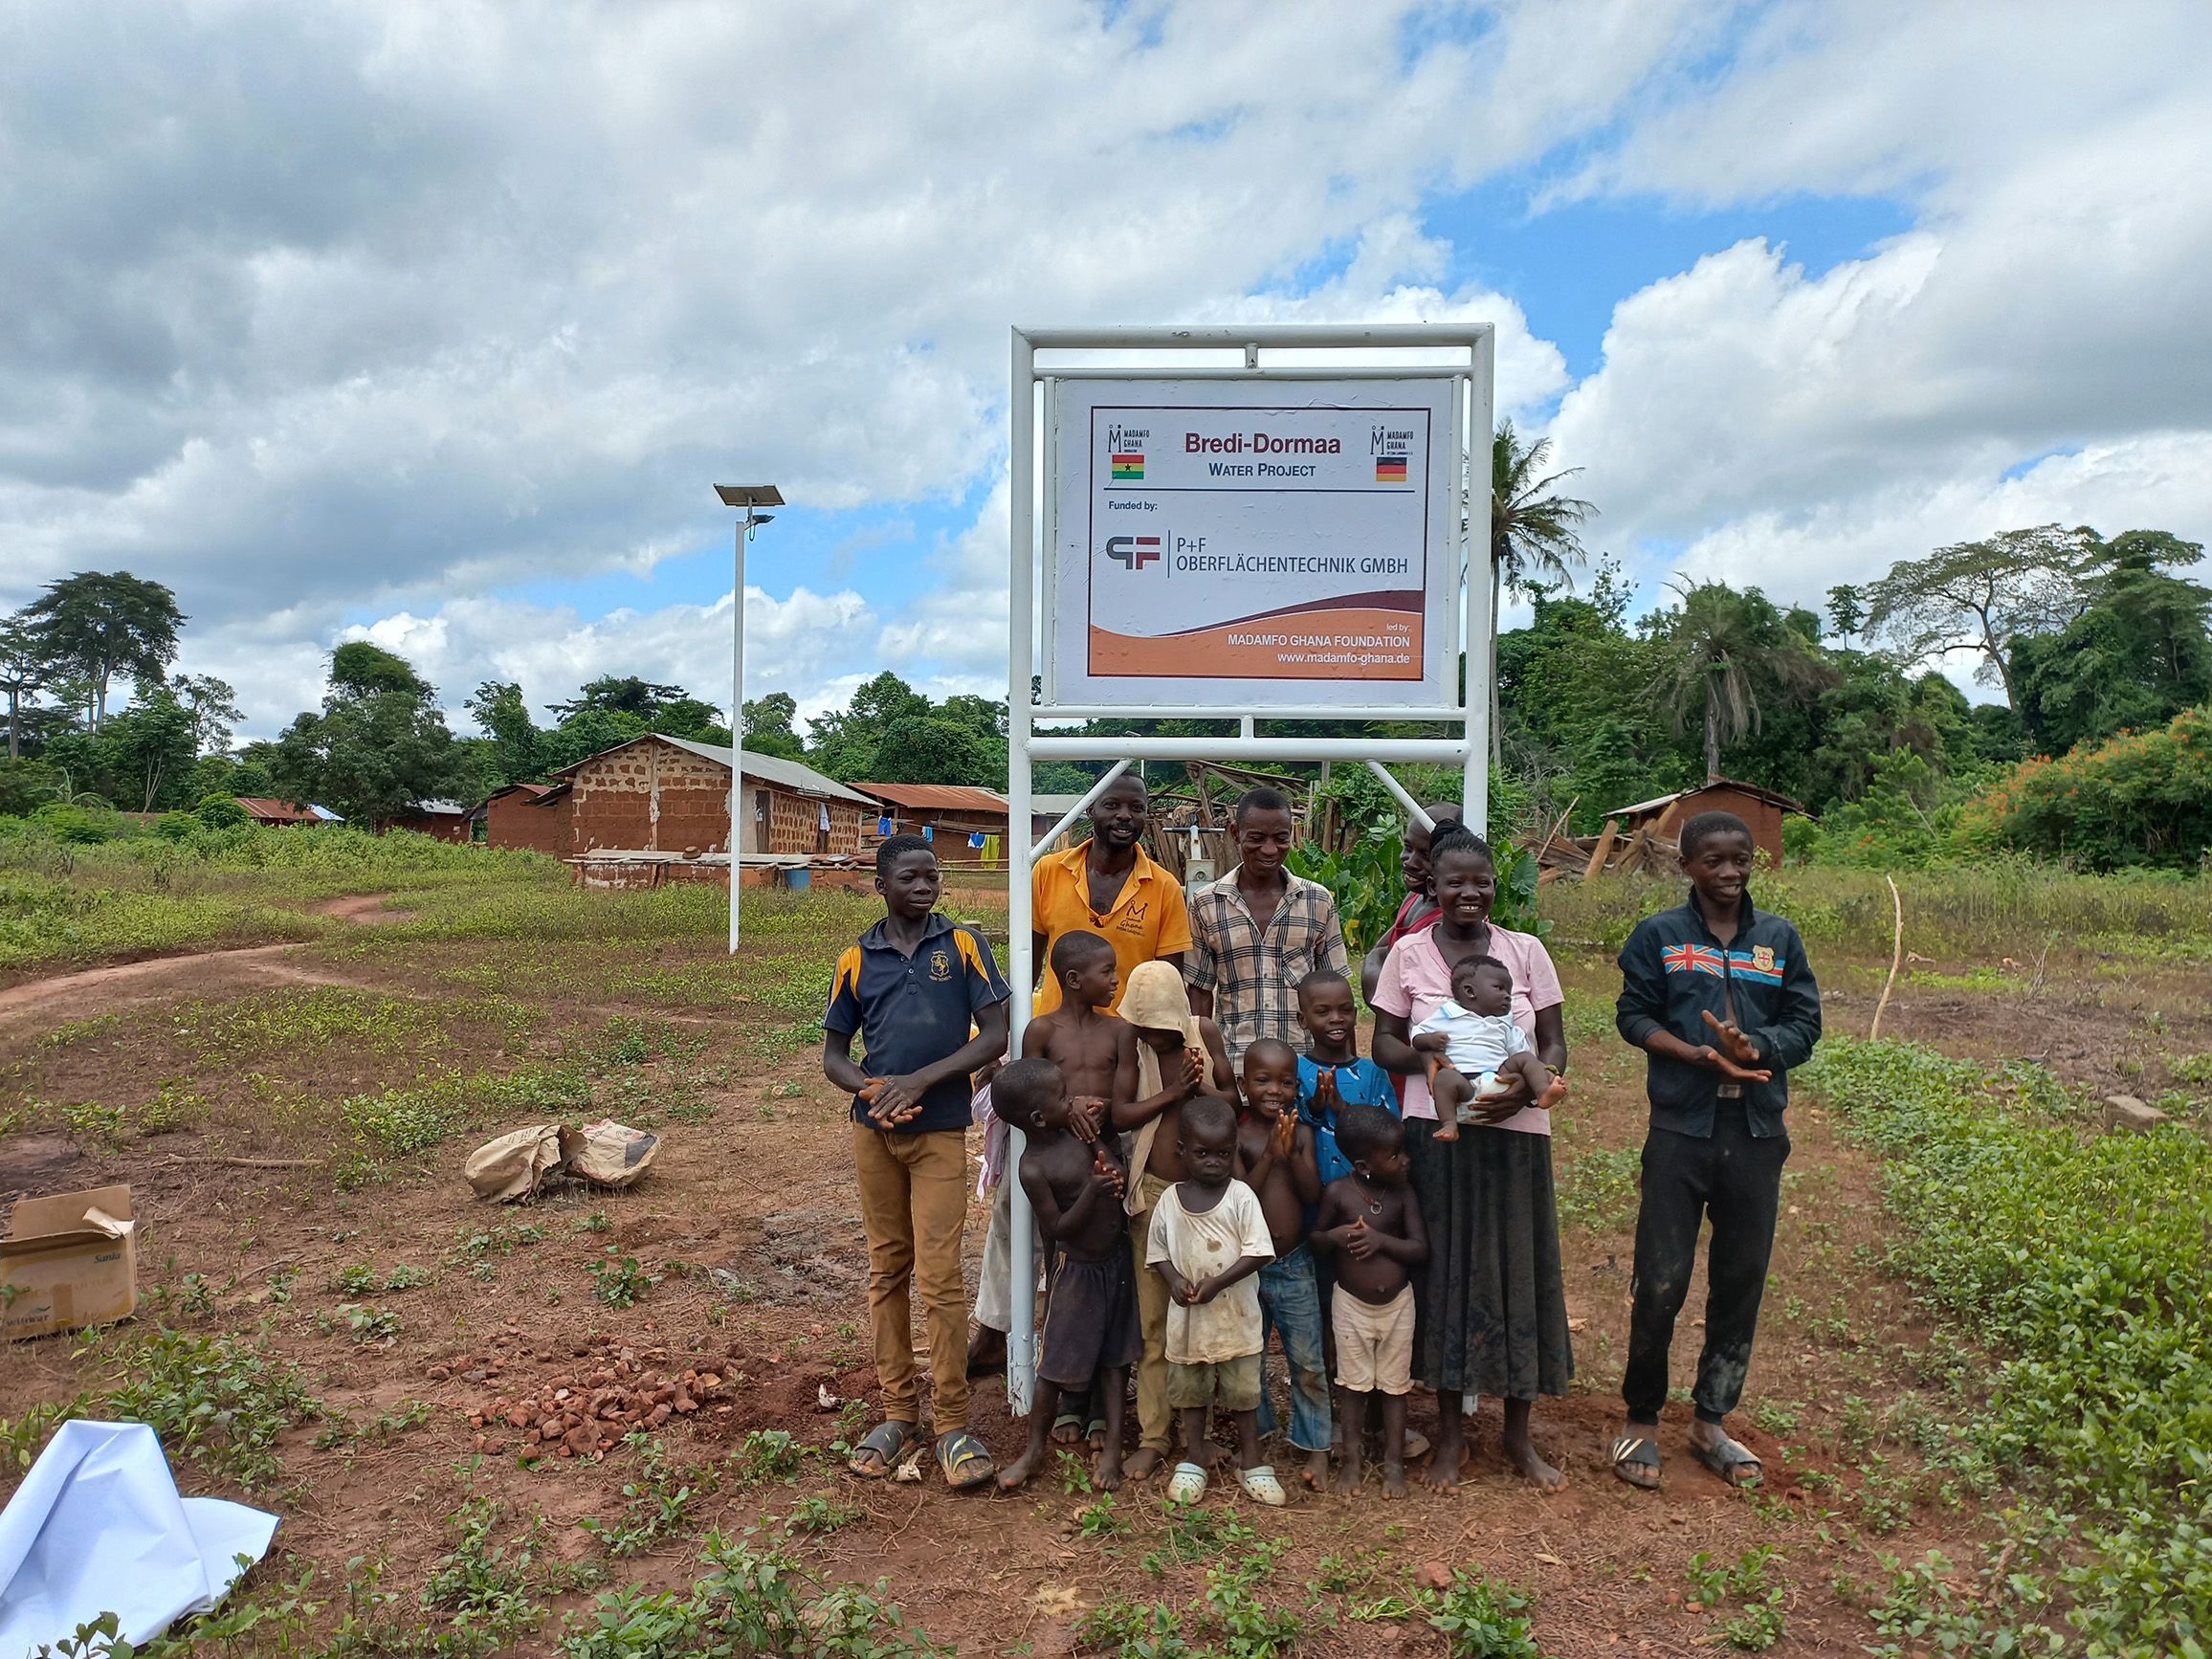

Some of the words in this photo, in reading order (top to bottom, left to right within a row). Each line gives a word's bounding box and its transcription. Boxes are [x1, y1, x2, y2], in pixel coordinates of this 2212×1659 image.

[1123, 430, 1150, 438] MADAMFO
[1387, 431, 1414, 440] MADAMFO
[1123, 439, 1142, 448] GHANA
[1185, 432, 1340, 454] Bredi-Dormaa
[1387, 441, 1406, 450] GHANA
[1208, 462, 1253, 476] WATER
[1258, 462, 1316, 476] PROJECT
[1108, 500, 1142, 510] Funded
[1144, 500, 1158, 512] by:
[1177, 537, 1206, 553] P+F
[1177, 554, 1356, 573] OBERFLÄCHENTECHNIK
[1360, 557, 1407, 574] GMBH
[1386, 623, 1398, 631] led
[1399, 623, 1410, 633] by:
[1228, 633, 1287, 647] MADAMFO
[1290, 634, 1332, 648] GHANA
[1334, 635, 1410, 649] FOUNDATION
[1277, 652, 1410, 666] www.madamfo-ghana.de
